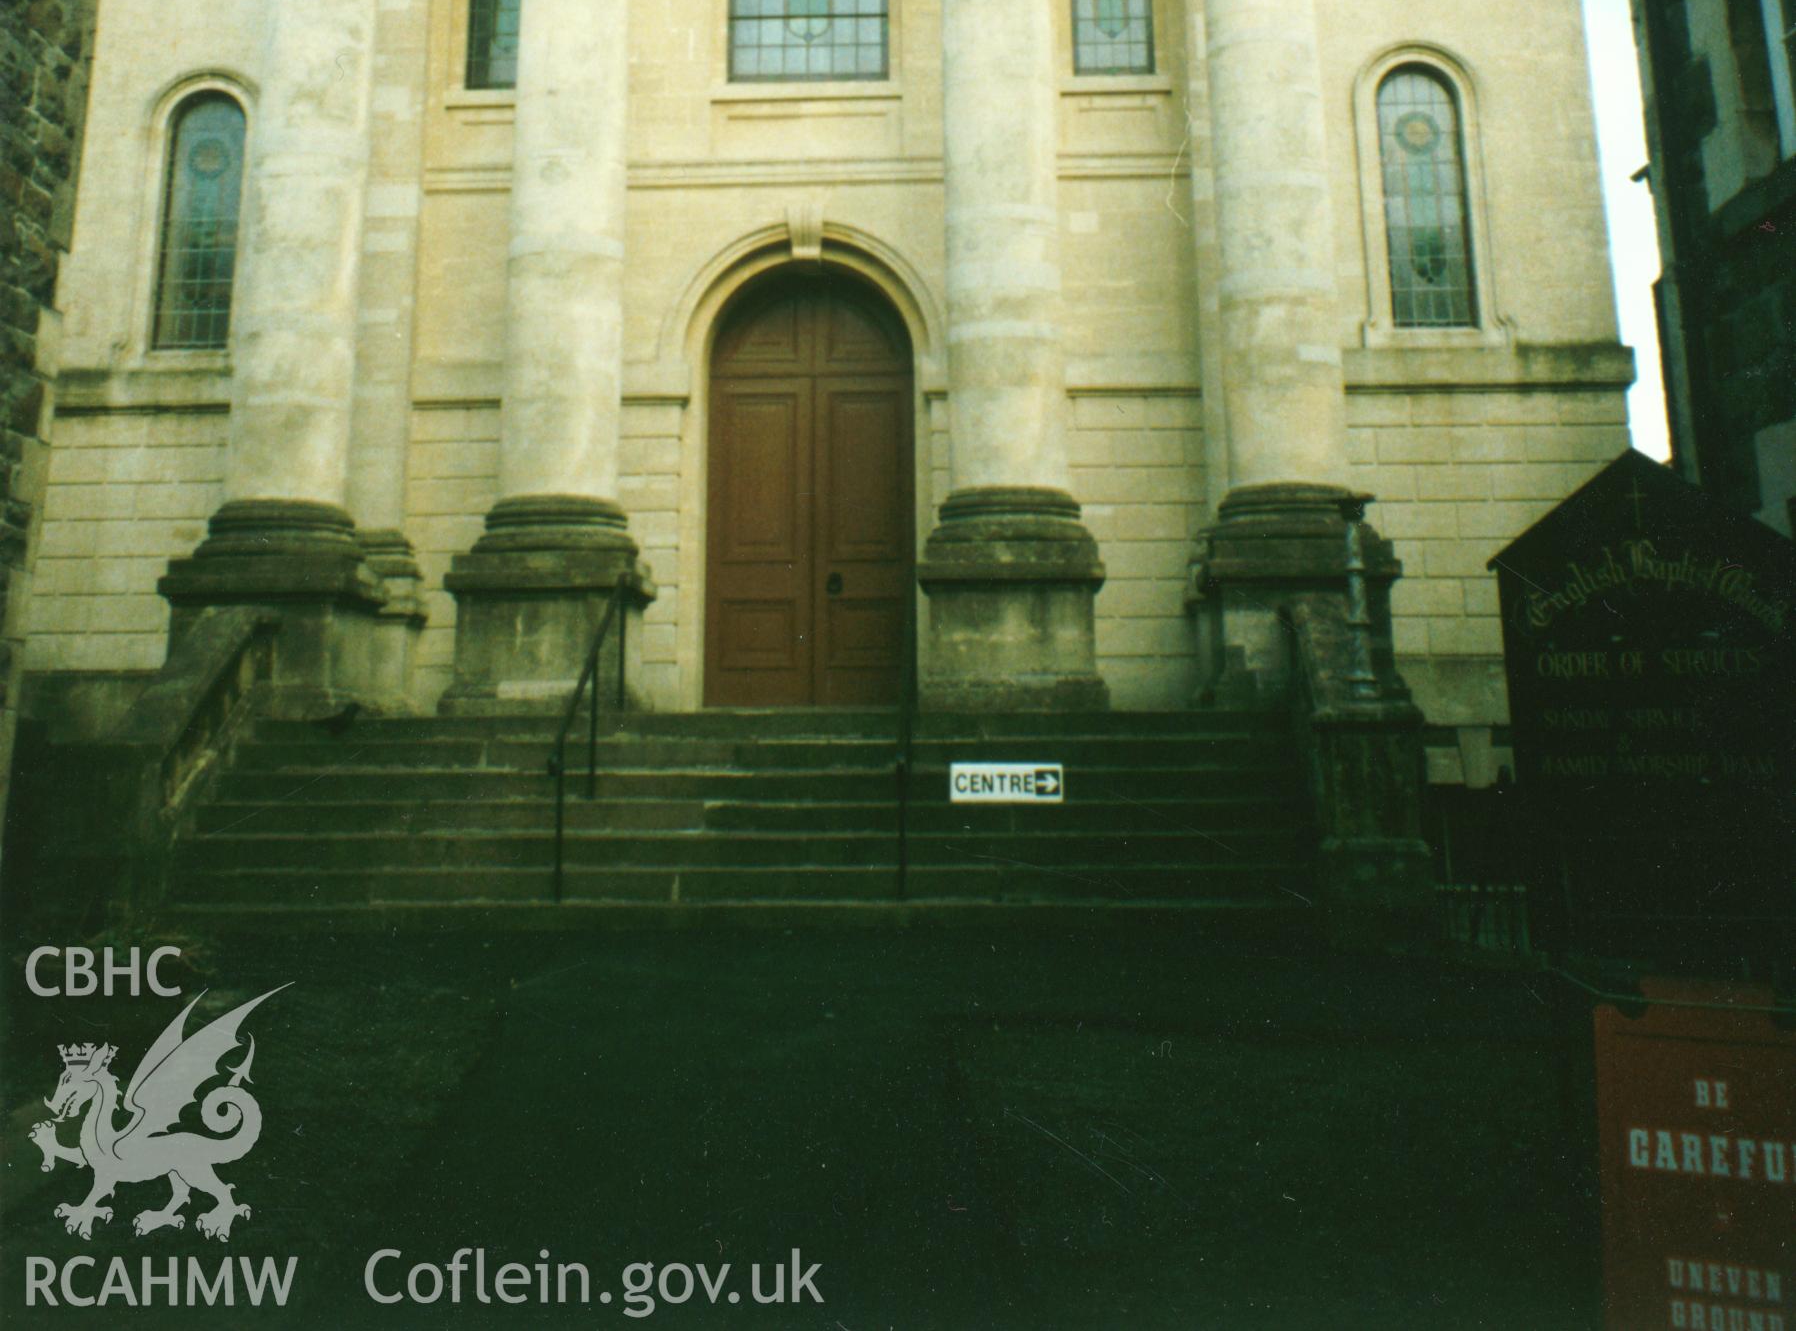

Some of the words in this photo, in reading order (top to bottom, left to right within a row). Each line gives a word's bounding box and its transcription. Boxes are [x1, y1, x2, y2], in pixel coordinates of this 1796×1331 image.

[1514, 546, 1627, 634] English
[1537, 651, 1609, 679] ORDER
[1620, 651, 1647, 675] OF
[1662, 648, 1760, 678] SERVICES
[954, 772, 1034, 793] CENTRE
[1693, 1078, 1729, 1109] BE
[1628, 1127, 1796, 1183] CAREFU
[1667, 1258, 1782, 1302] UNEVEN
